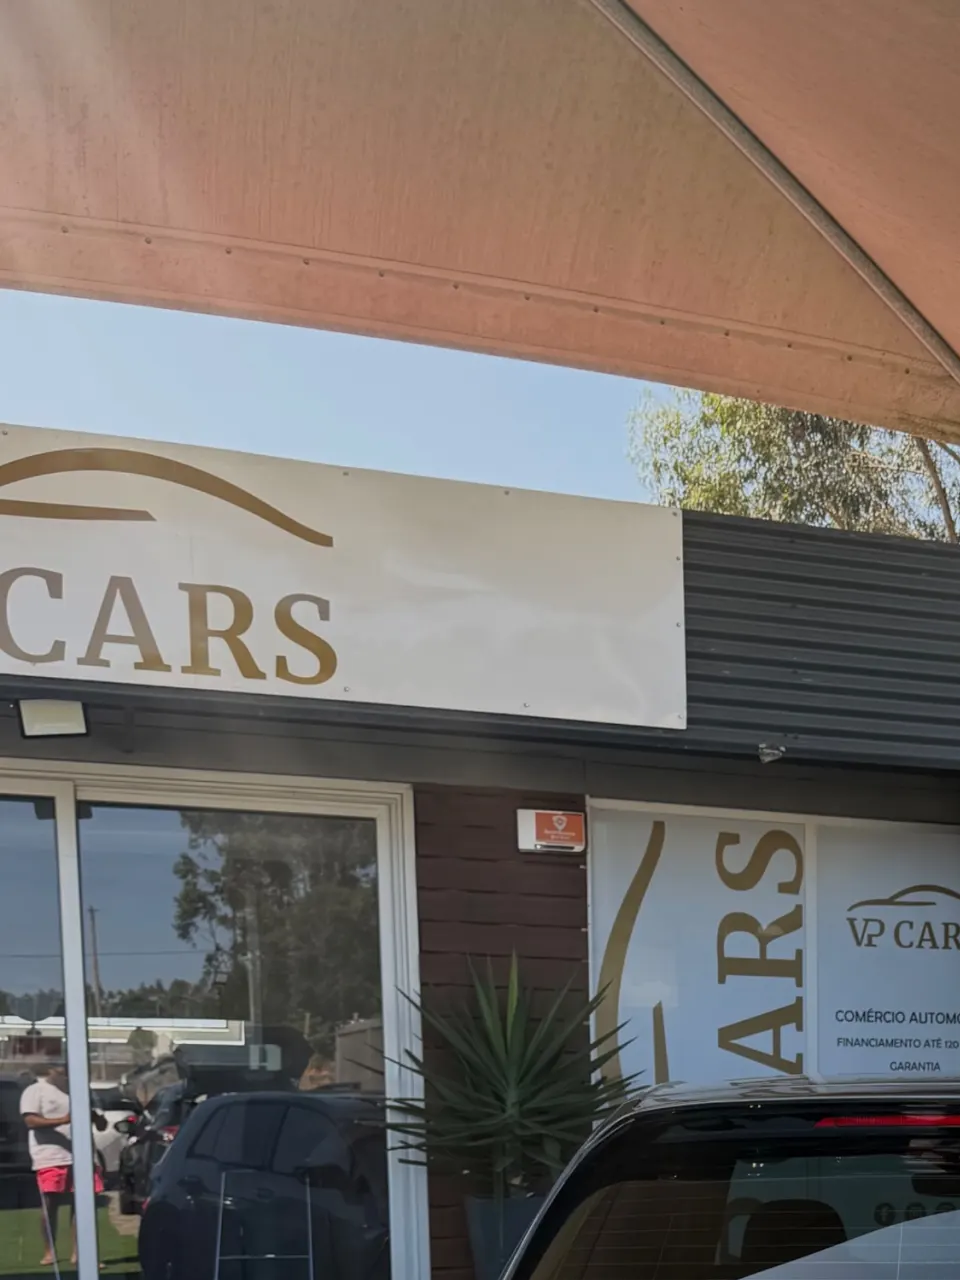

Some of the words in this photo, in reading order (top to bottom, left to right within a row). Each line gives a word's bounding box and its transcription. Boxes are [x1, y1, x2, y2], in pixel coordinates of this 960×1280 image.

[0, 566, 338, 686] CARS
[846, 917, 885, 948] VP
[835, 1008, 906, 1024] COMÉRCIO
[836, 1037, 921, 1049] FINANCIAMENTO
[923, 1037, 942, 1049] ATÉ
[944, 1040, 959, 1049] 120
[889, 1061, 941, 1072] GARANTIA
